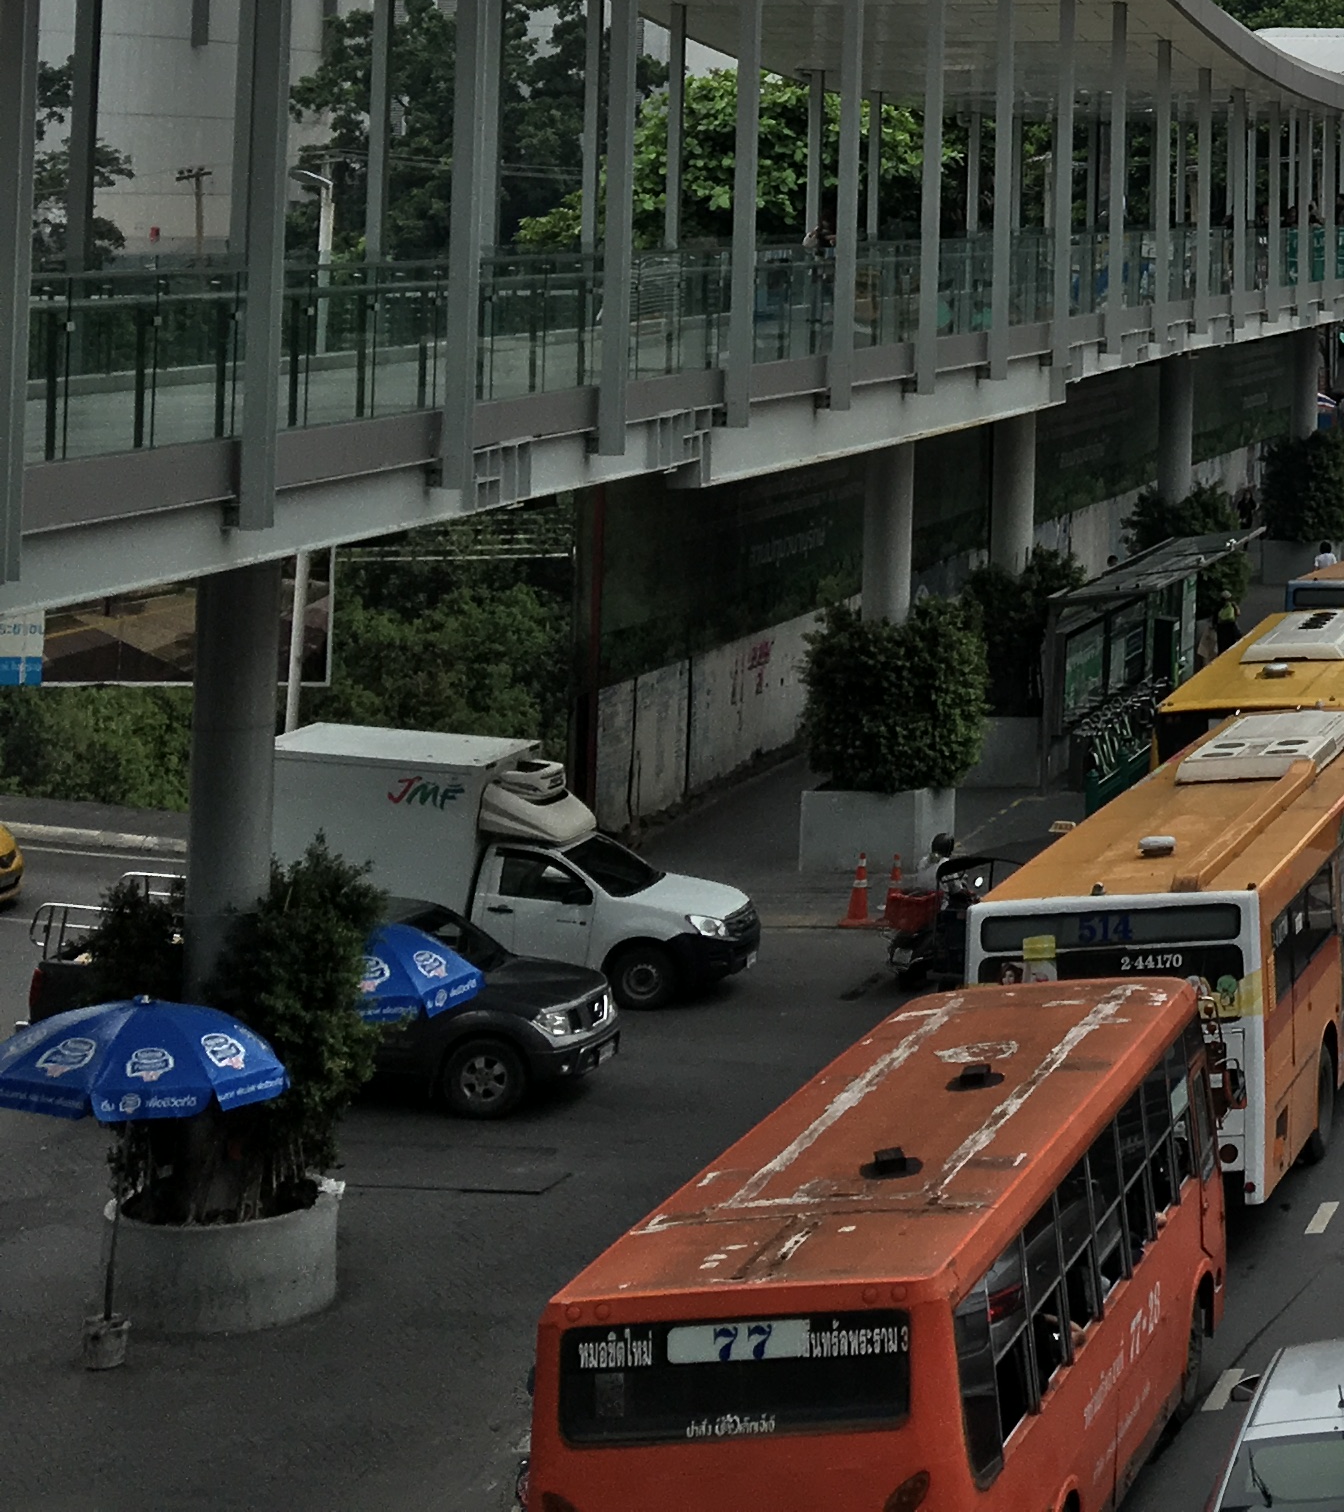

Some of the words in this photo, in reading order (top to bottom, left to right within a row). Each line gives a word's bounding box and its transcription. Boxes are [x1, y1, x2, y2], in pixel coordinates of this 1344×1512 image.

[387, 775, 466, 811] JMF
[1078, 915, 1133, 943] 514
[578, 1328, 653, 1369] หมอชิตใหม่
[713, 1325, 773, 1363] 77
[802, 1319, 898, 1358] นทรัลพระราม
[900, 1325, 909, 1352] 3
